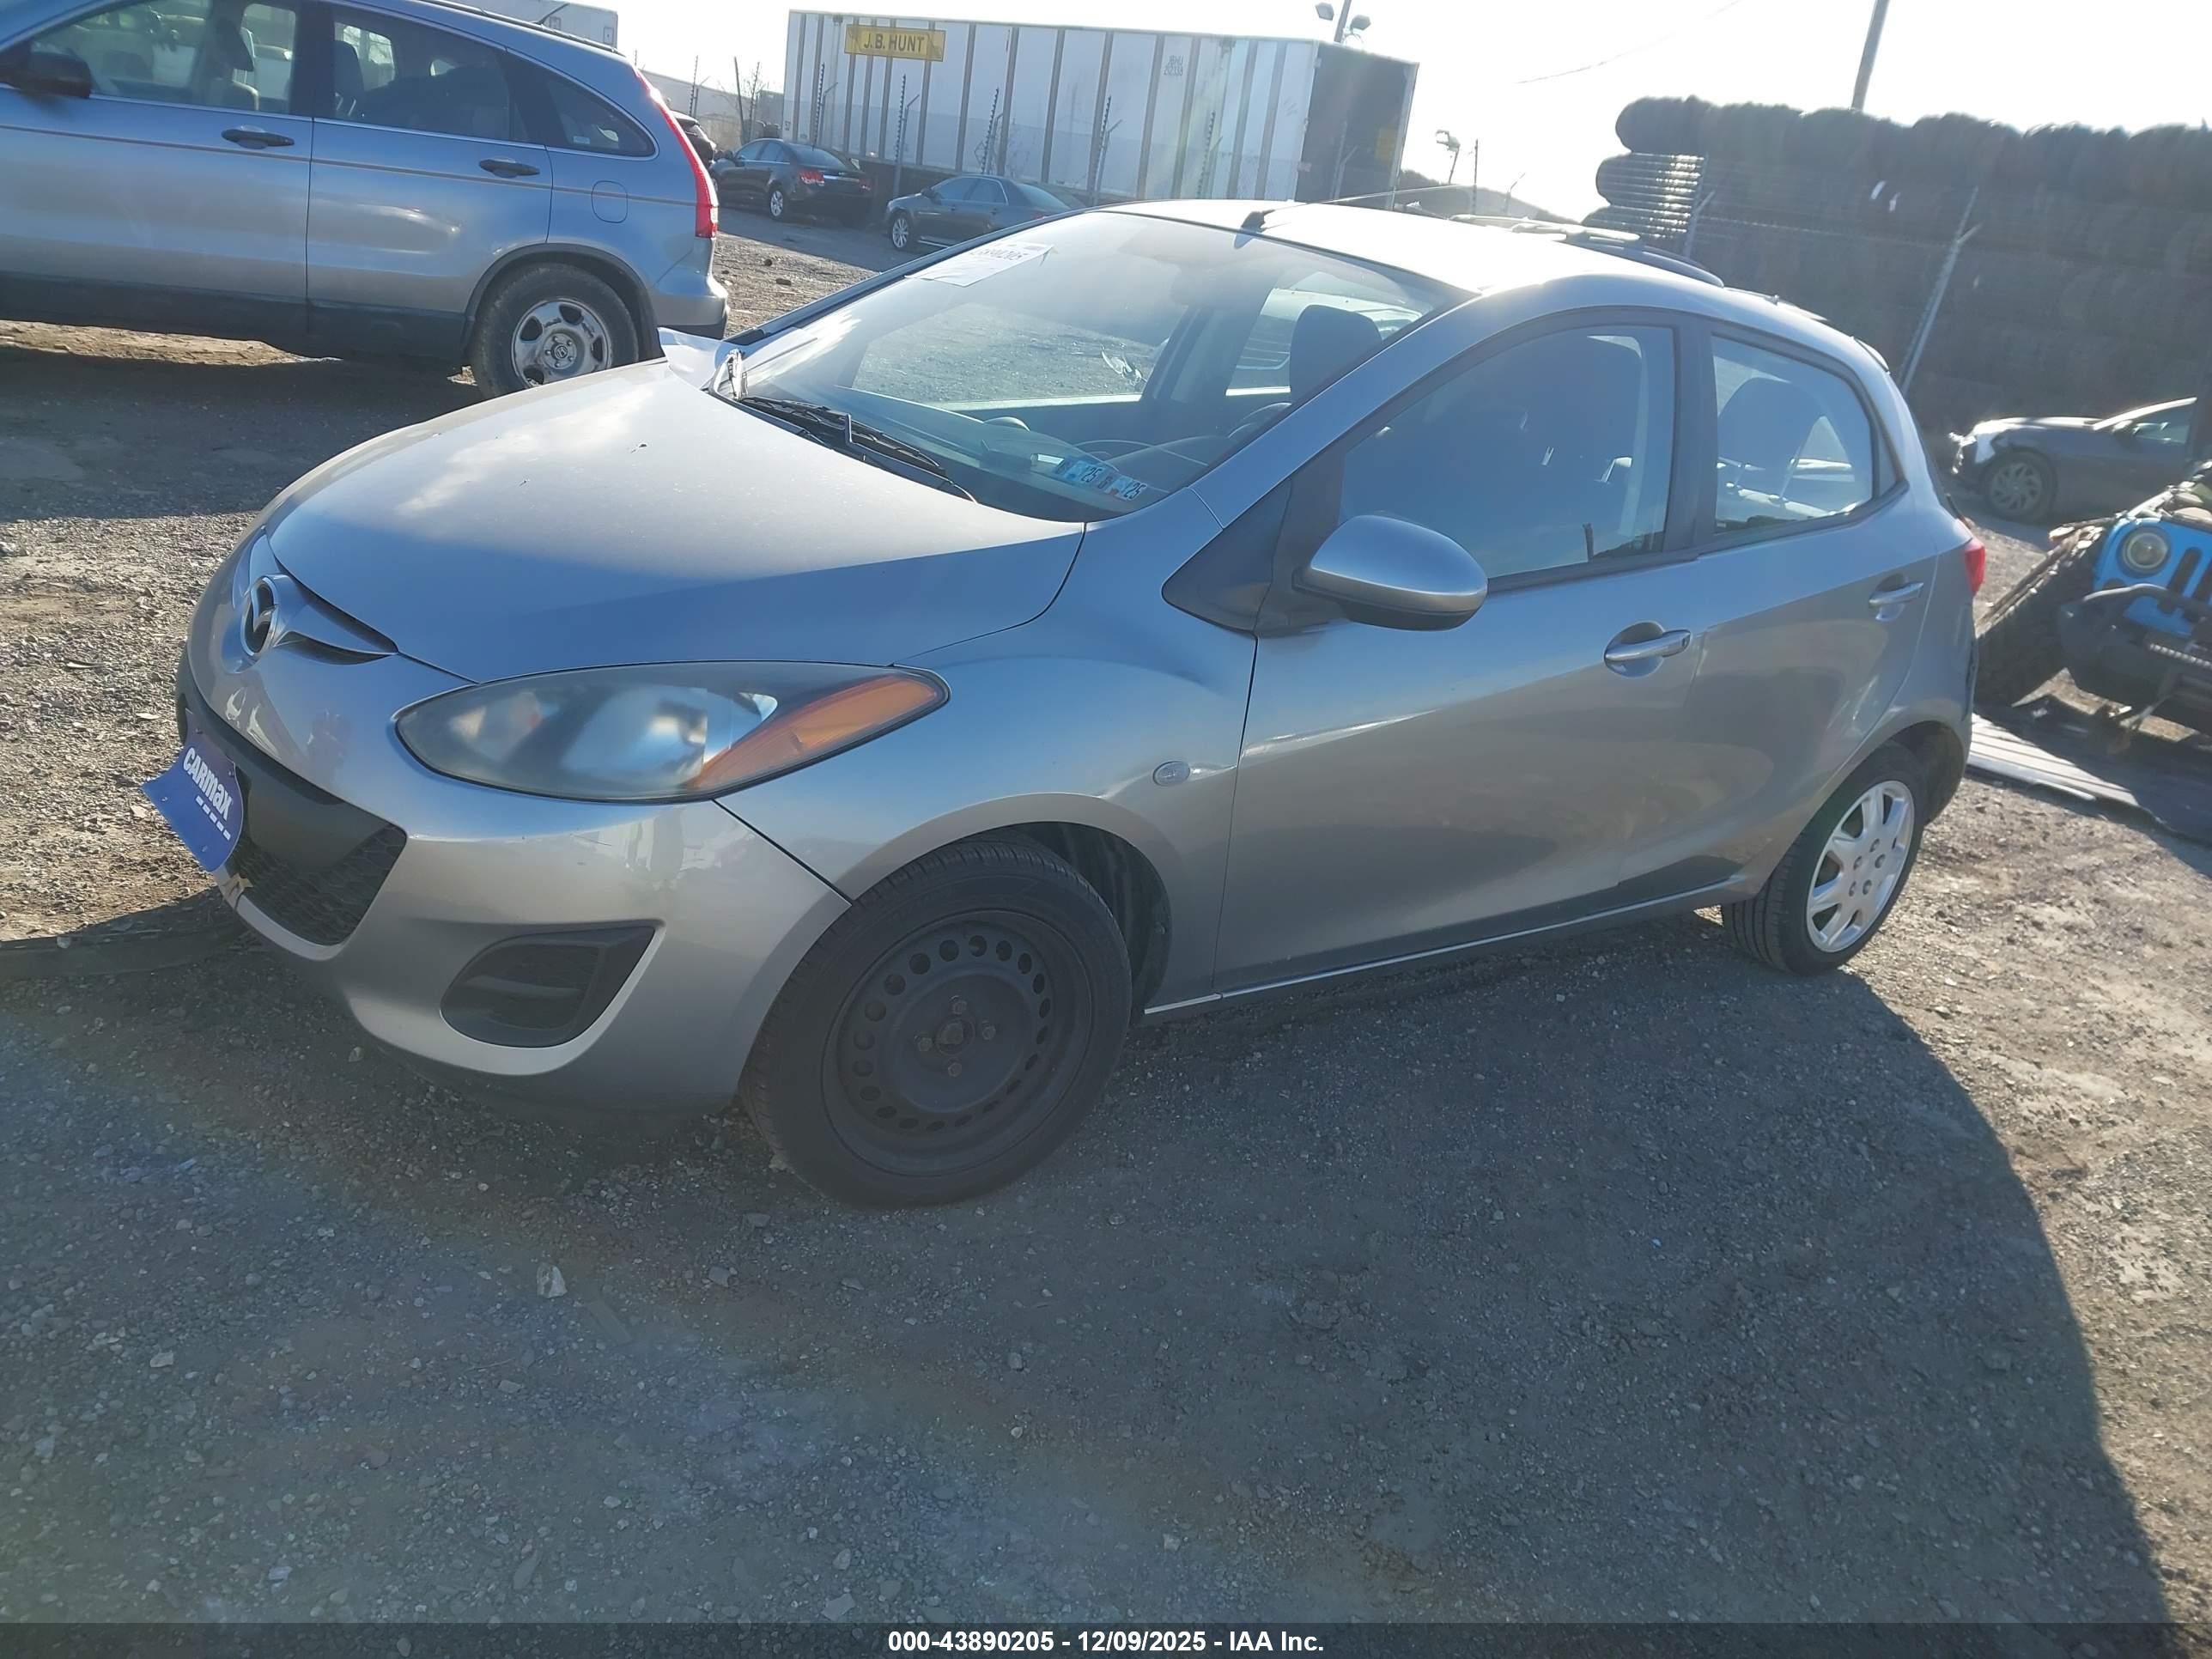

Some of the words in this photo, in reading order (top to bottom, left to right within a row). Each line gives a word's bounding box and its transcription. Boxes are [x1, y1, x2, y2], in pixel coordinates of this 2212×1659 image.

[888, 34, 925, 52] HUNT
[1080, 465, 1103, 483] 25
[1123, 483, 1146, 499] 25
